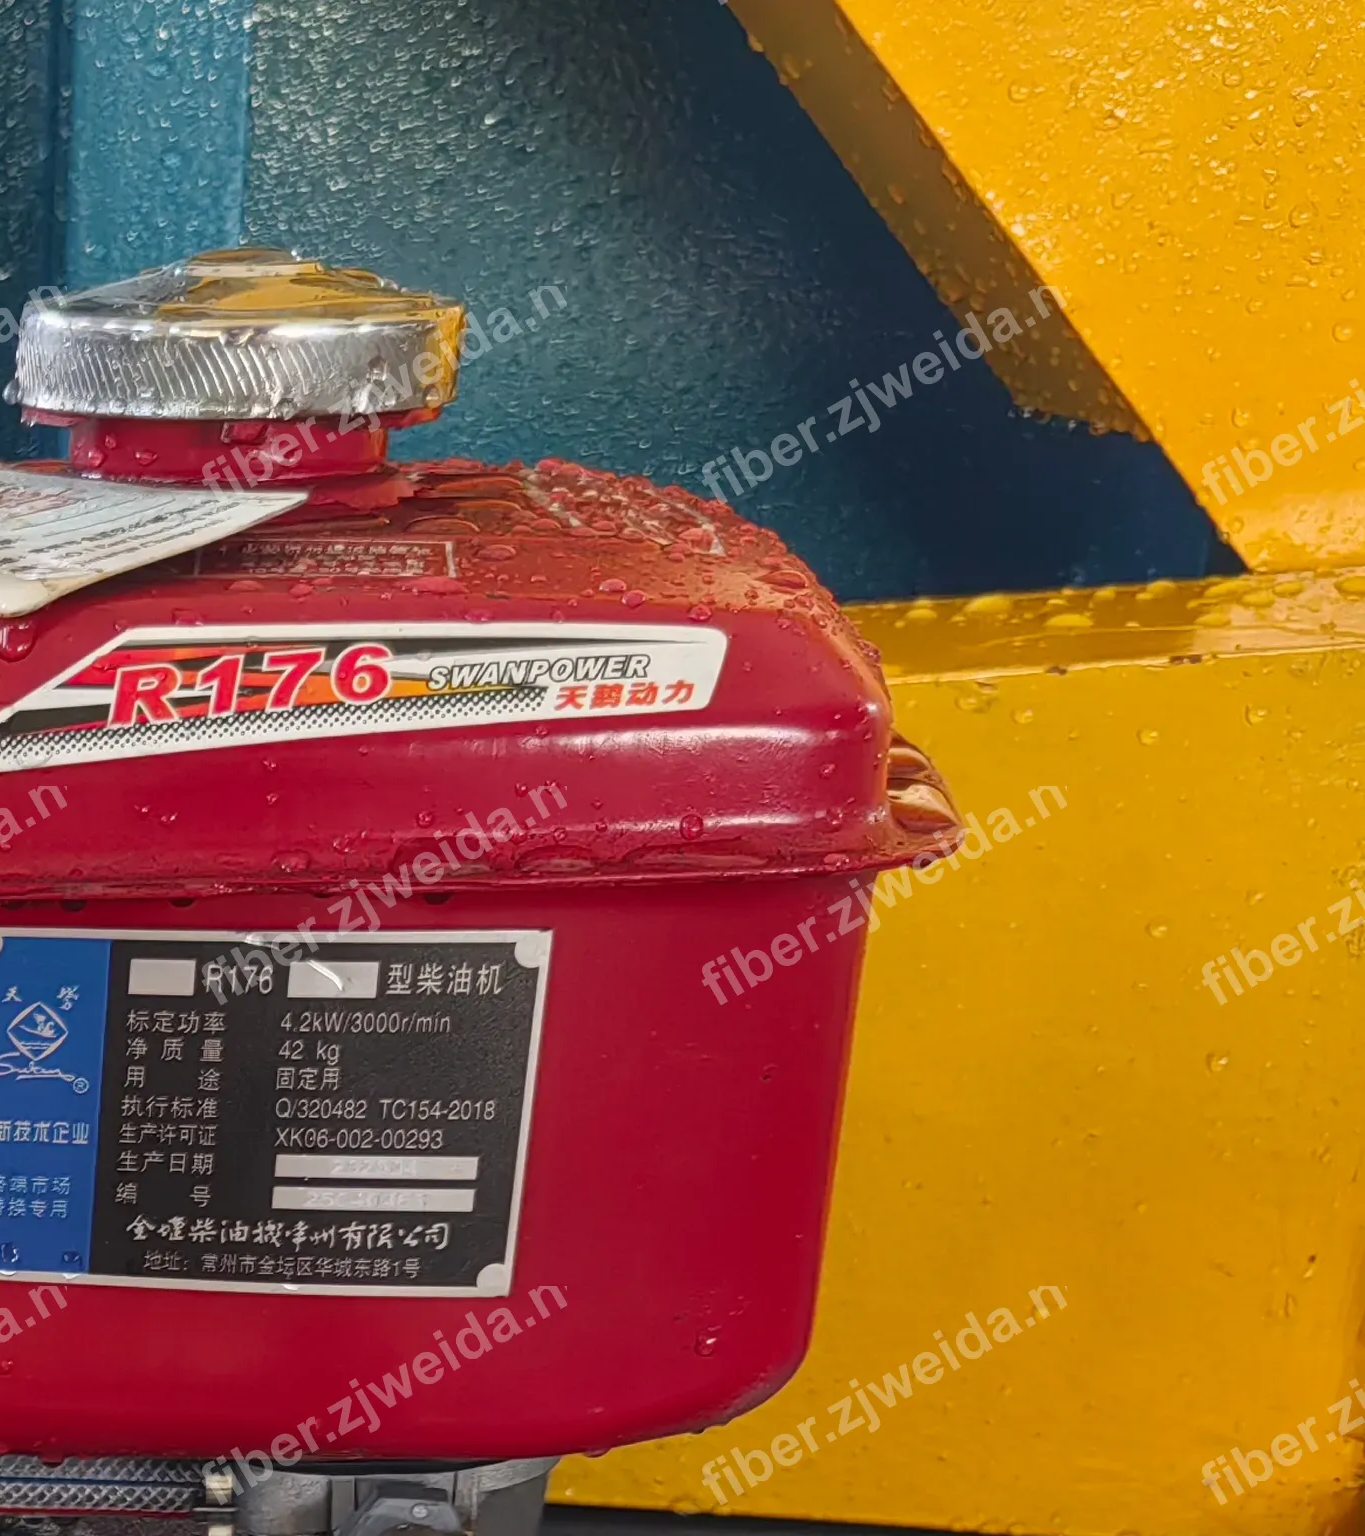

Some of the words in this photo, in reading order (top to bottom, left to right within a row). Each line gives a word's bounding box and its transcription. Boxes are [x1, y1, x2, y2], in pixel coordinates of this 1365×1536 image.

[427, 654, 652, 690] SWANPOWER
[108, 642, 393, 729] R176
[555, 679, 695, 711] 天鹅动力
[206, 966, 273, 995] R176
[386, 963, 504, 997] 型柴油机
[125, 1010, 227, 1034] 标定功率
[280, 1011, 451, 1036] 4.2kW/3000r/min
[278, 1040, 304, 1061] 42
[315, 1040, 341, 1065] kg
[275, 1068, 342, 1092] 固定用
[120, 1096, 219, 1120] 执行标准
[275, 1099, 367, 1121] Q/320482
[379, 1099, 497, 1122] TC154-2018
[118, 1124, 218, 1148] 生产许可证
[274, 1127, 445, 1151] XK06-002-00293
[116, 1152, 215, 1176] 生产日期
